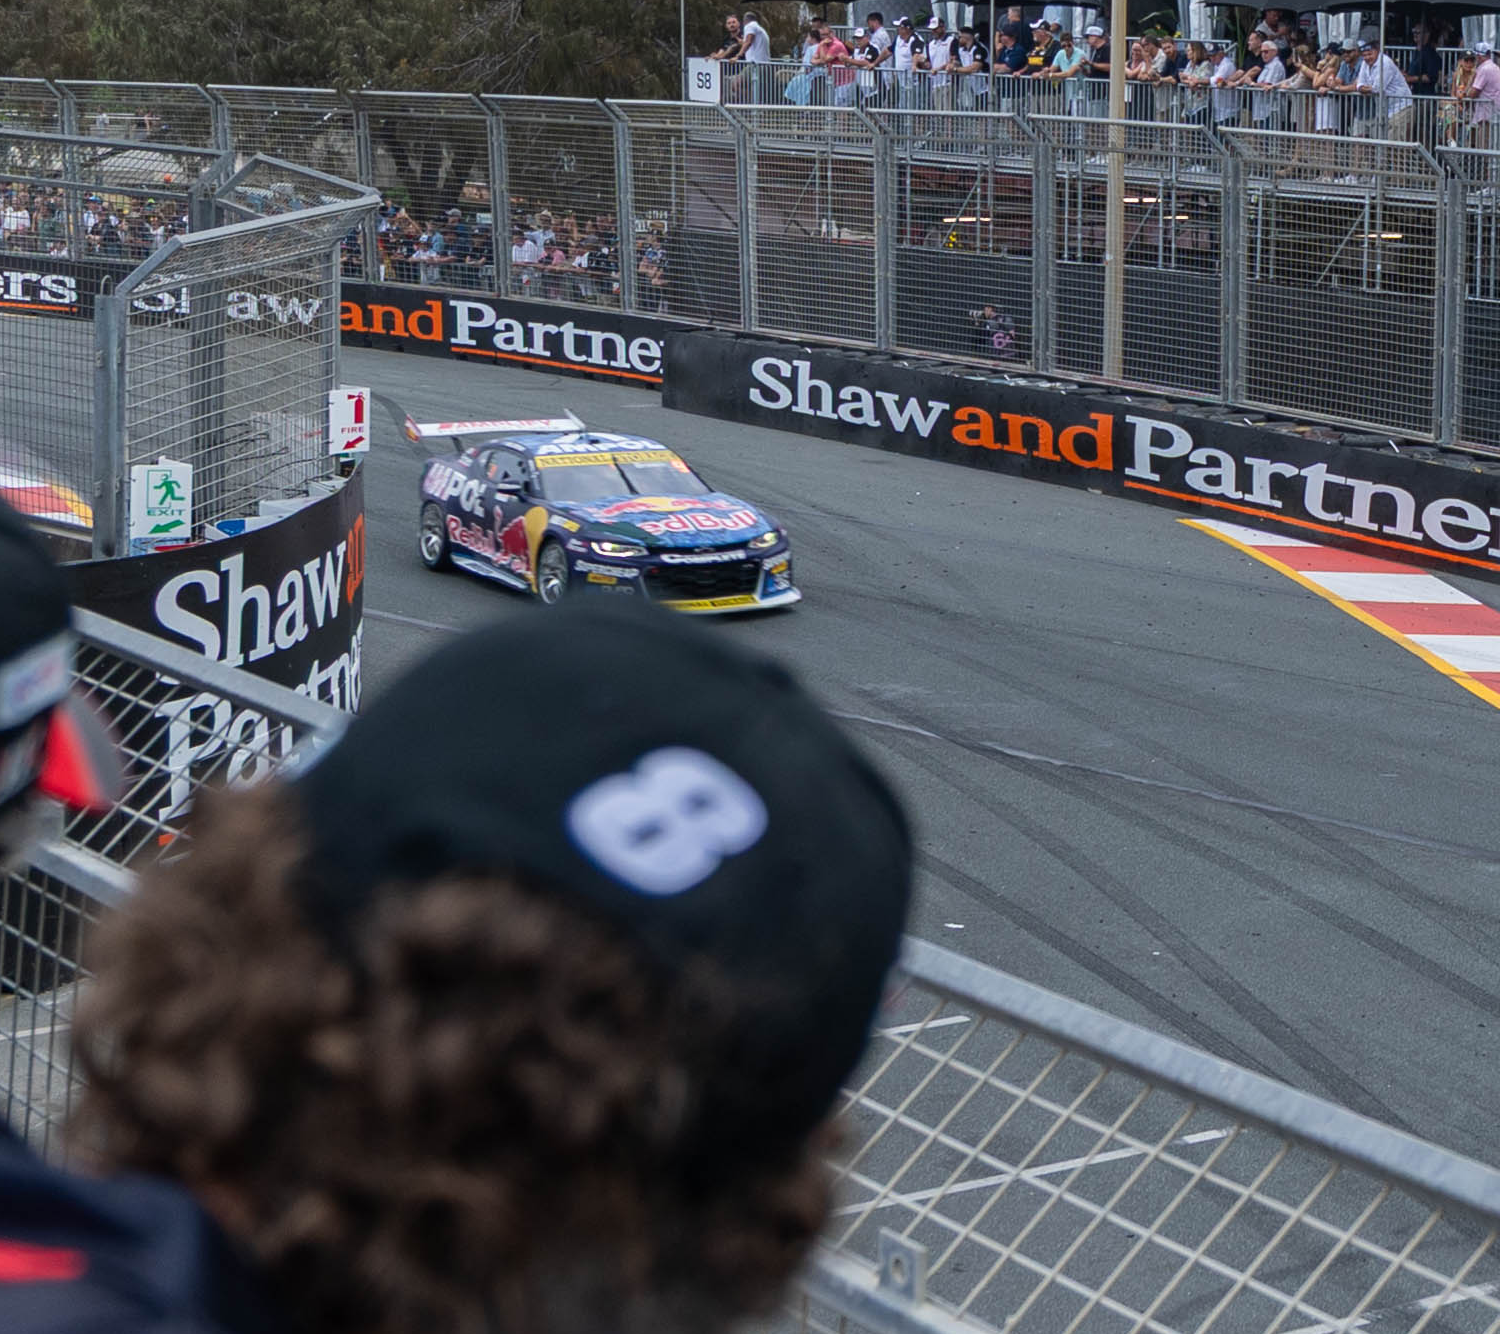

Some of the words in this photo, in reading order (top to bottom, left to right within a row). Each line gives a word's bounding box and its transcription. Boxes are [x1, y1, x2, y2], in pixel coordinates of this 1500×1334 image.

[697, 72, 711, 89] S8
[449, 300, 663, 374] Partne
[536, 441, 668, 455] AMPOL
[748, 356, 949, 439] Shaw
[951, 404, 1113, 471] and
[146, 508, 185, 517] EXIT
[155, 541, 347, 685] Shaw
[563, 744, 770, 895] 8
